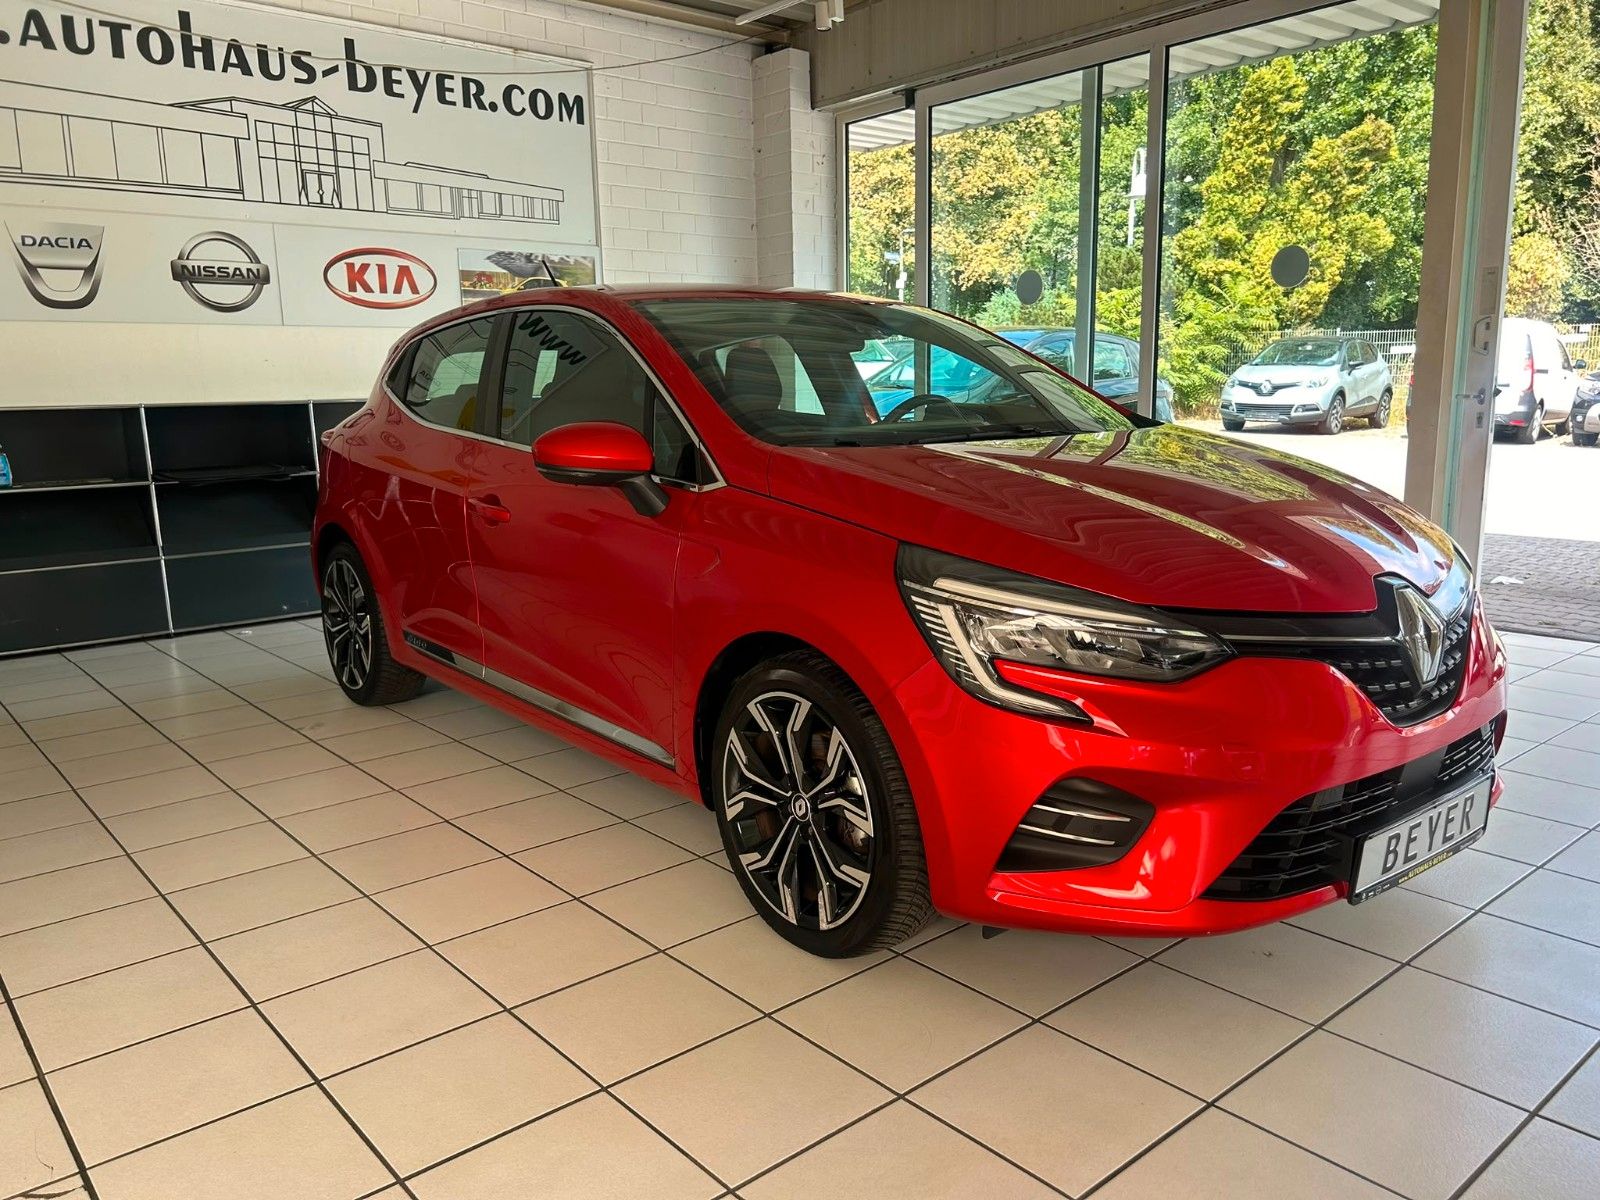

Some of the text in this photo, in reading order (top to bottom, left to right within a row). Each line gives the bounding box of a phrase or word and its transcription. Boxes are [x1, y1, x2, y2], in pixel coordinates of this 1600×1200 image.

[20, 234, 94, 250] DACIA
[180, 264, 261, 280] NISSAN
[344, 261, 420, 295] KIA
[1381, 792, 1475, 875] BEYER
